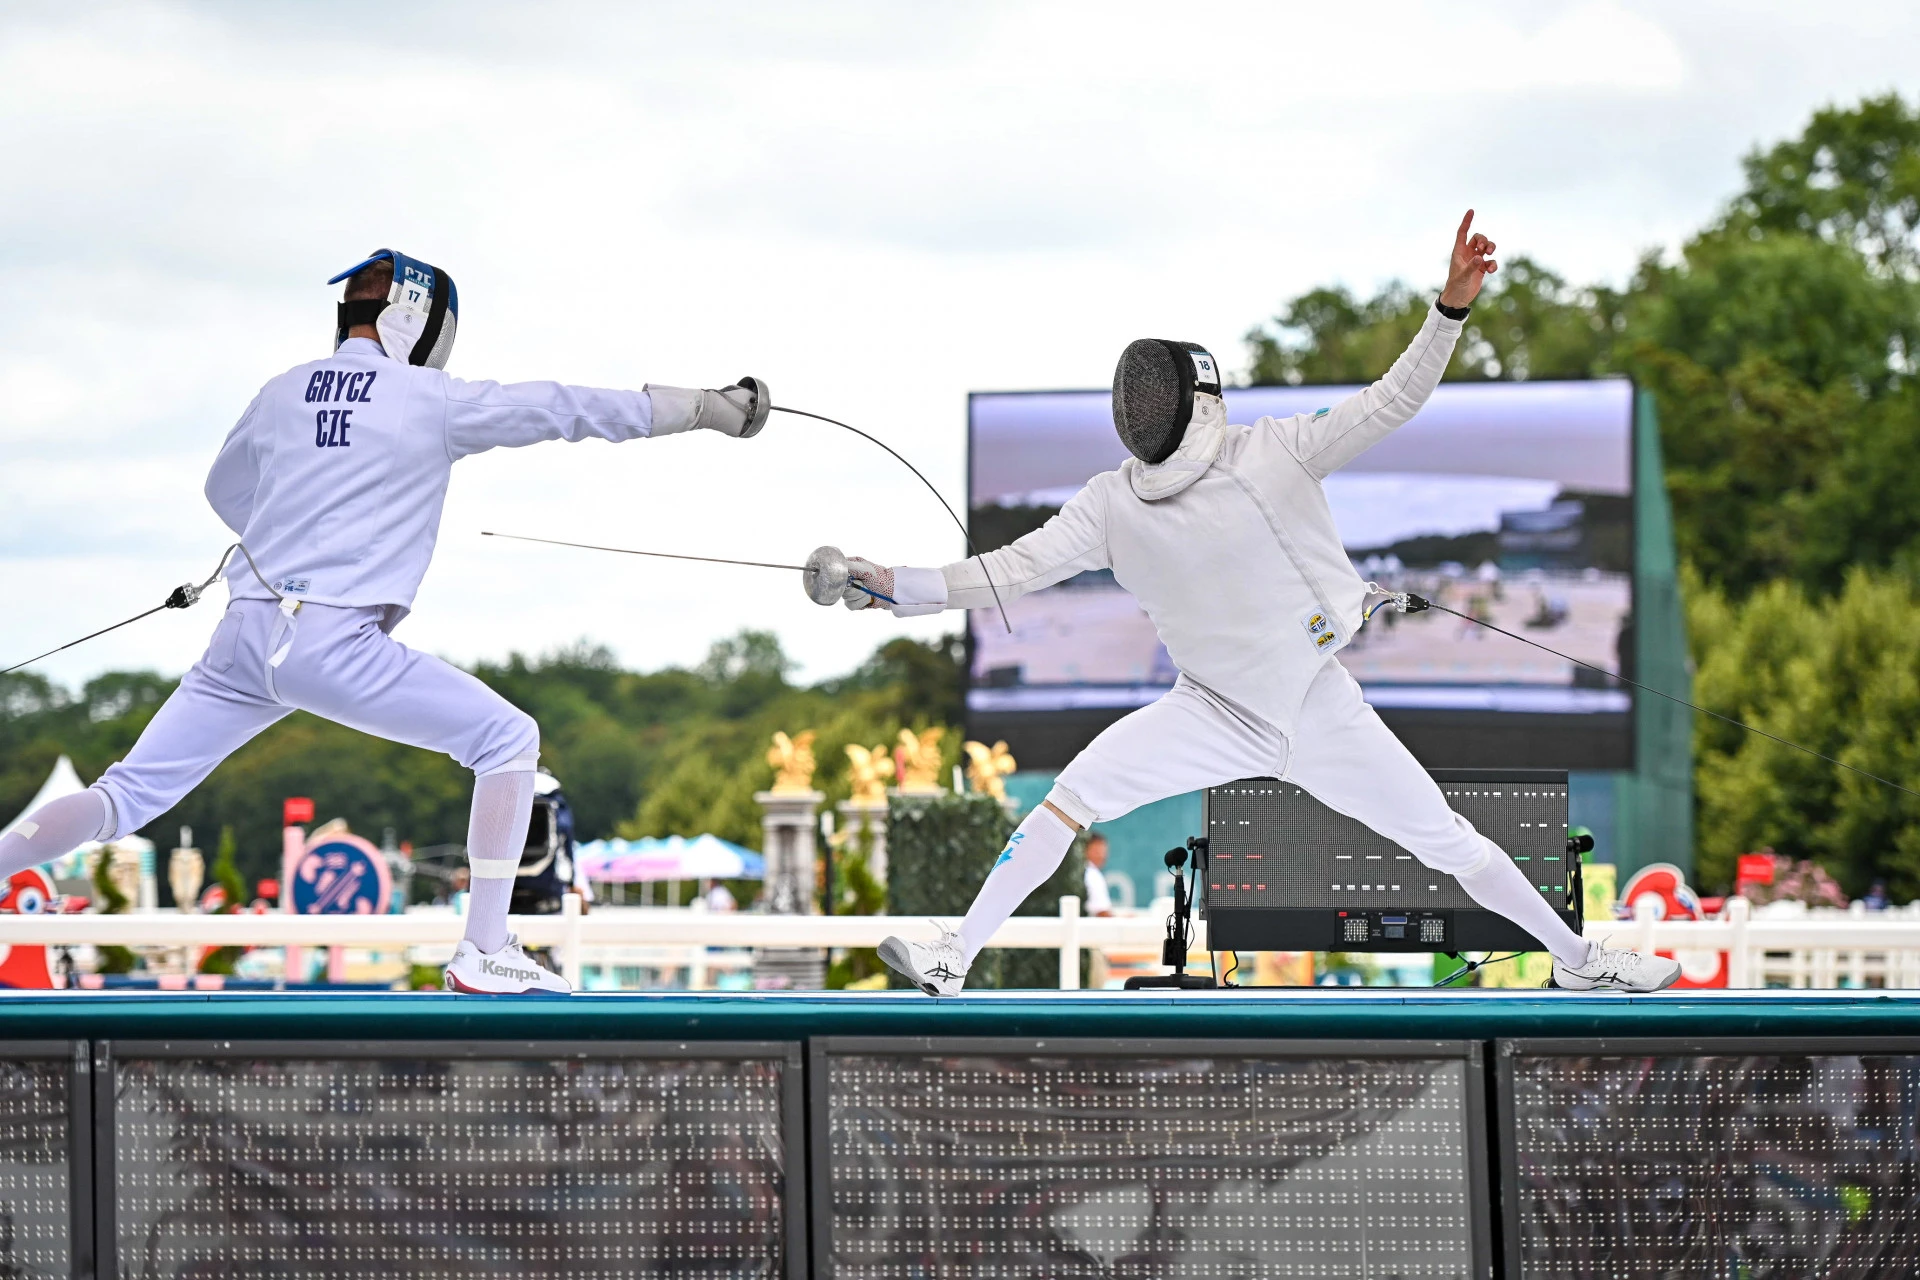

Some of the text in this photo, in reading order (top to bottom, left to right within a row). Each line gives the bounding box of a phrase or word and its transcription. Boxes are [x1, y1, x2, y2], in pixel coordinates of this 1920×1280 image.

[408, 289, 421, 303] 17
[1198, 360, 1211, 371] 18
[305, 370, 377, 403] GRYCZ
[316, 409, 354, 448] CZE
[482, 959, 541, 983] Kempa
